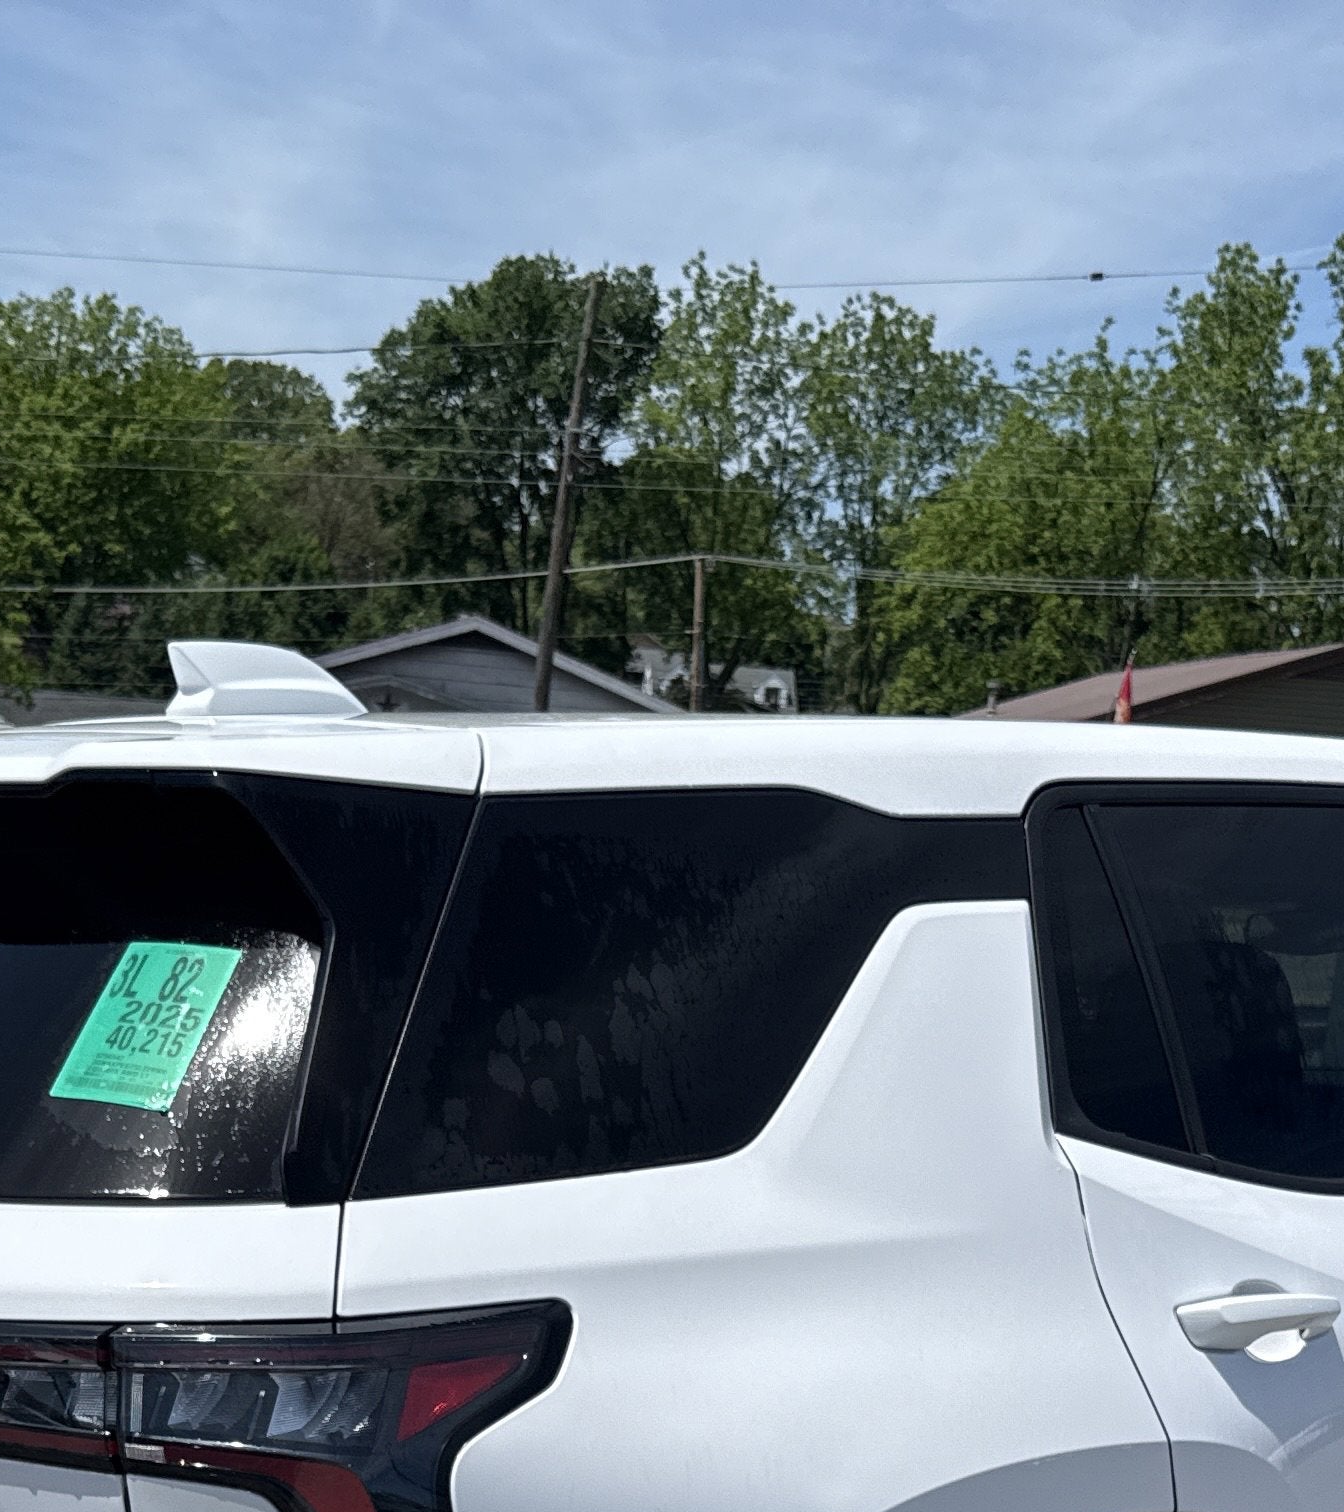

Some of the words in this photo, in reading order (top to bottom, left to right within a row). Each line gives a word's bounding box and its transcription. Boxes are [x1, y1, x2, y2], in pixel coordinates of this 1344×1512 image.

[158, 956, 205, 1003] 82
[118, 1000, 205, 1032] 2025
[105, 1025, 187, 1058] 40,215
